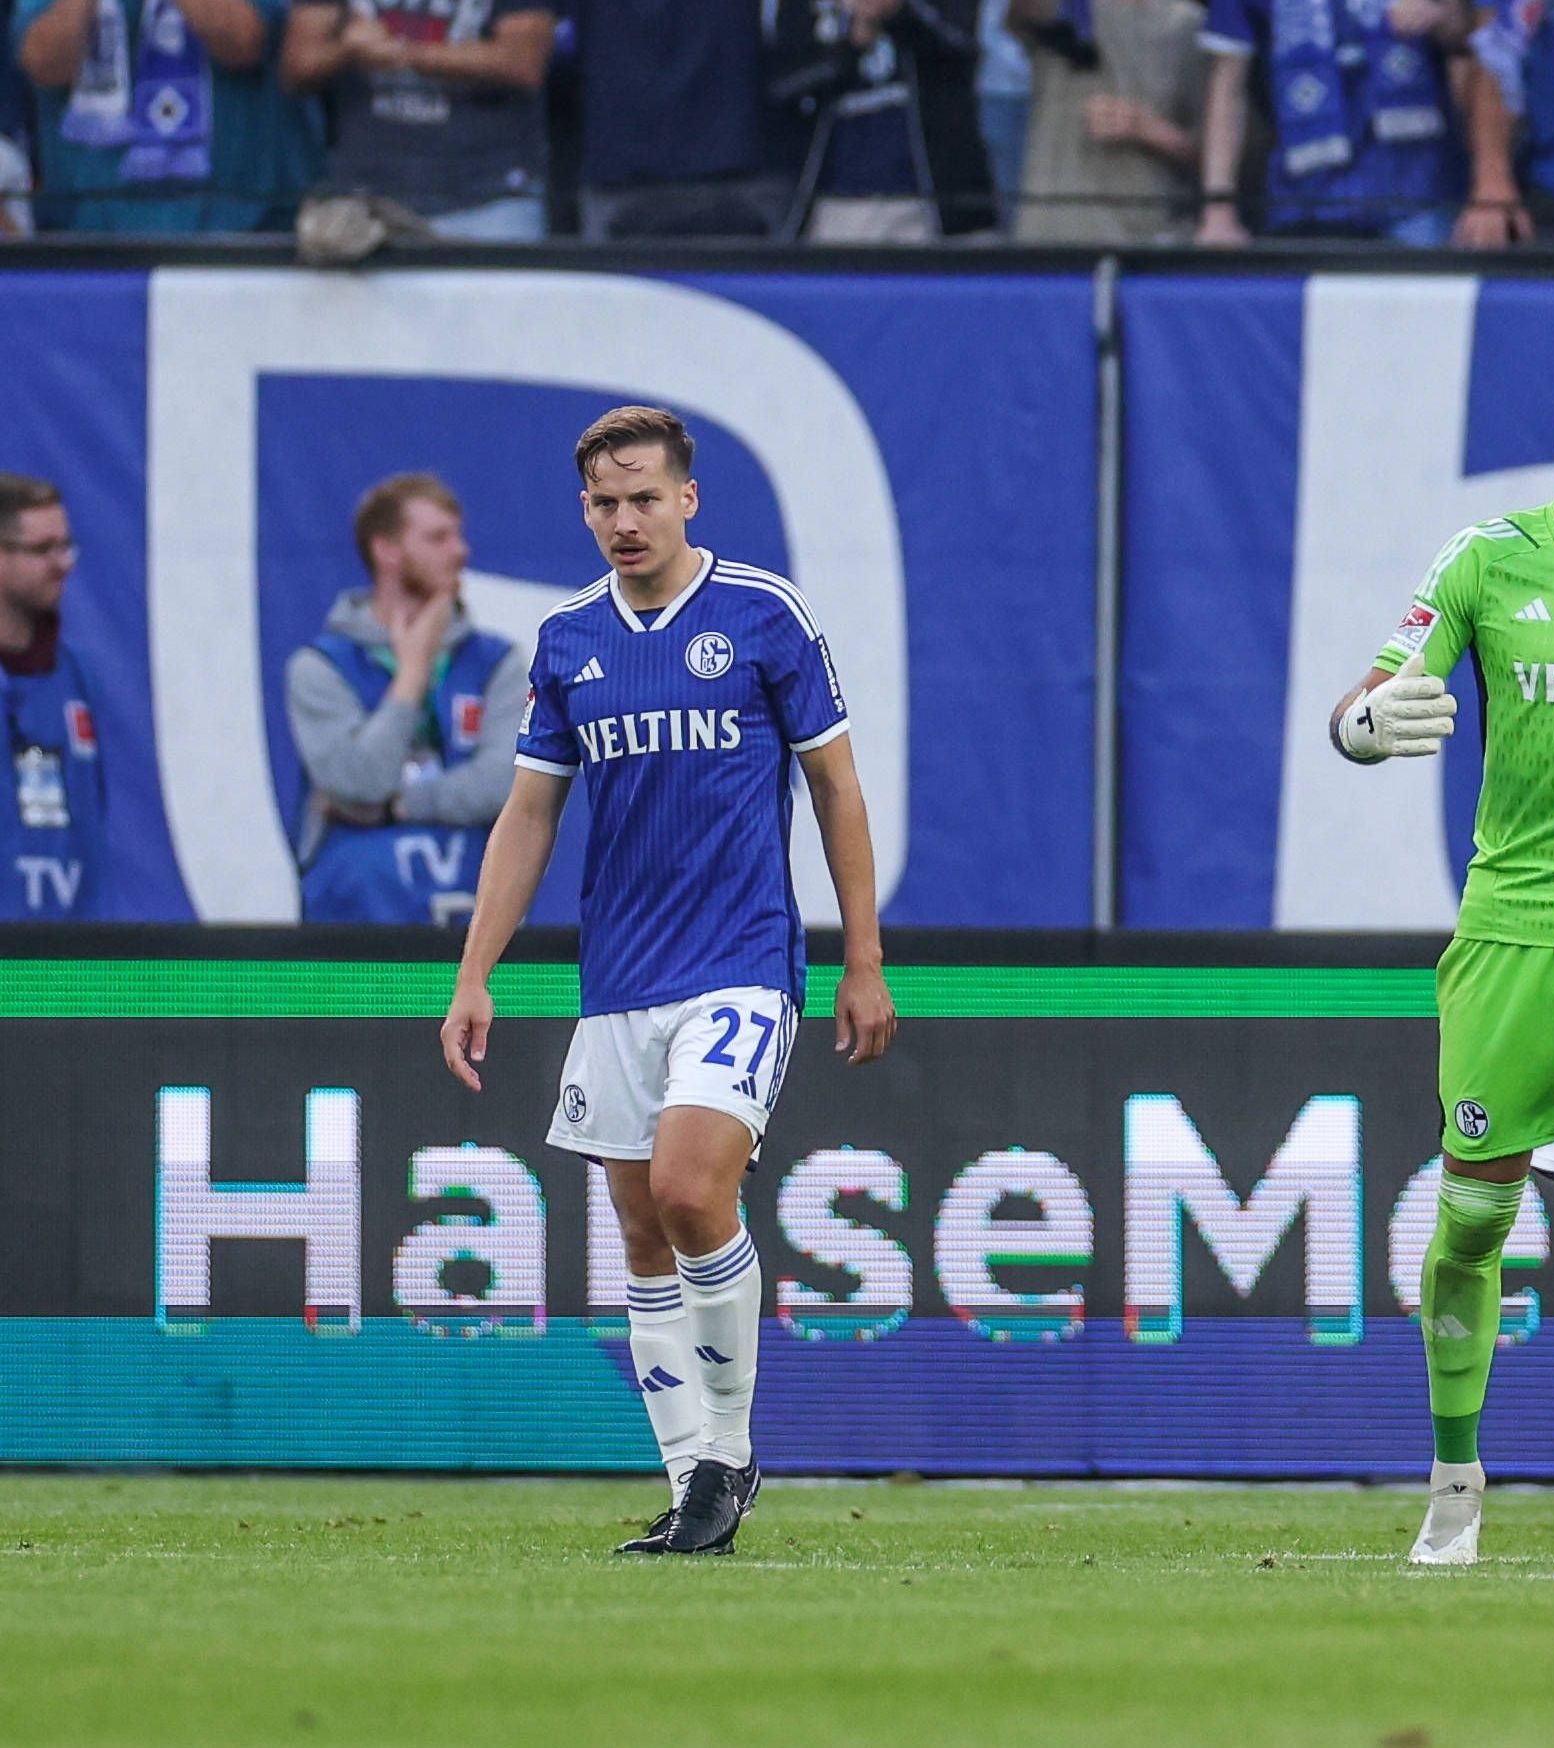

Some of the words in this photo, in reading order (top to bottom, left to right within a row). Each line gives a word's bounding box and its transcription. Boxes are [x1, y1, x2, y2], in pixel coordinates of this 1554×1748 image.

[577, 708, 742, 763] VELTINS
[16, 856, 83, 910] TV
[701, 1006, 778, 1075] 27
